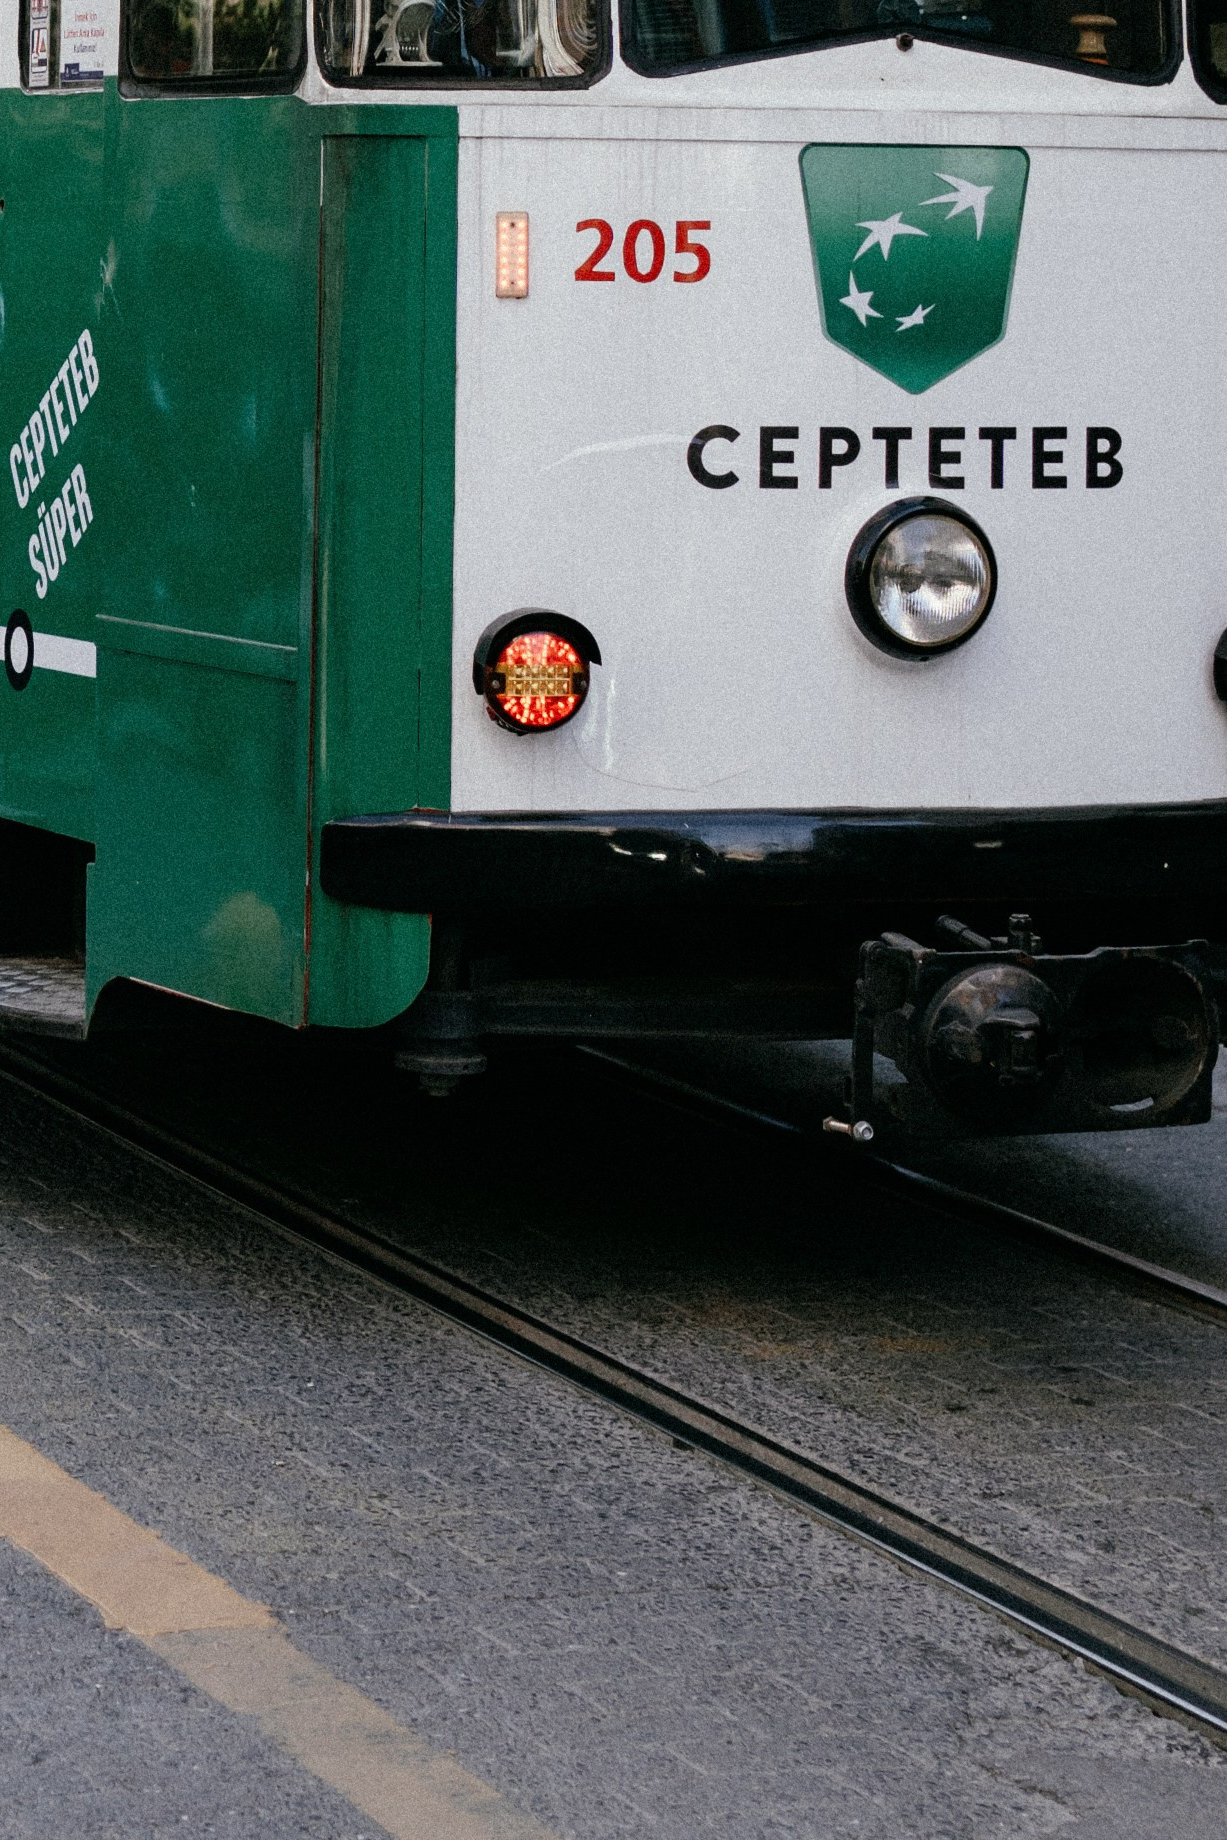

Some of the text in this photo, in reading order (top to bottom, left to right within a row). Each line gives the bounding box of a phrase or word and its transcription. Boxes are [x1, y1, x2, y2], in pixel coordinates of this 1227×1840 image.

[574, 217, 713, 284] 205
[9, 328, 100, 509] CEPTETEB
[685, 423, 1124, 491] CEPTETEB
[28, 463, 94, 600] SÜPER
